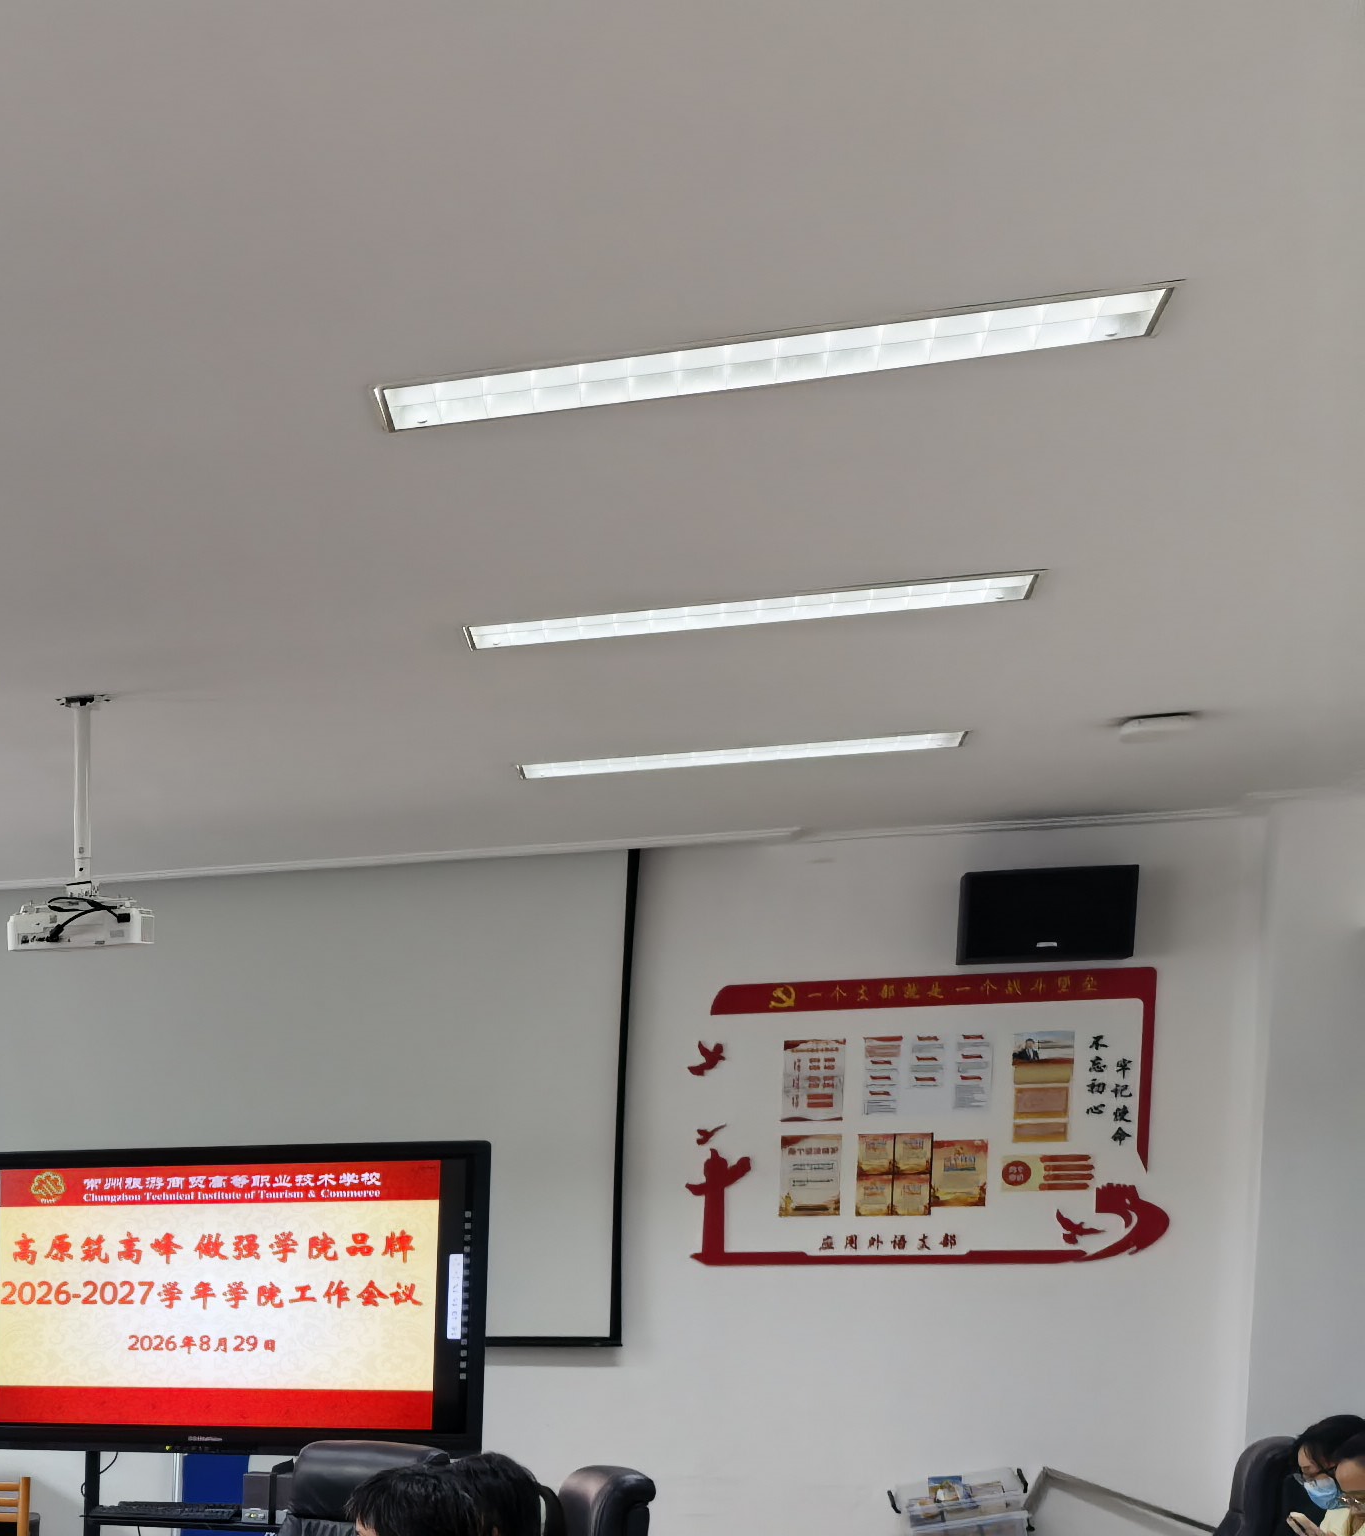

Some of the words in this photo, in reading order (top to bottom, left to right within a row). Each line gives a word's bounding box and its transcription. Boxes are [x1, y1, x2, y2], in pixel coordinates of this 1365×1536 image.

[1085, 1034, 1109, 1115] 不忘初心
[1110, 1057, 1133, 1146] 牢记使命
[82, 1171, 382, 1191] 常州旅游商贸高等职业技术学校
[197, 1190, 242, 1200] Institute
[244, 1190, 256, 1199] of
[257, 1189, 304, 1199] Tourism
[307, 1190, 317, 1198] &
[12, 1231, 184, 1265] 高原筑高峰
[193, 1229, 417, 1264] 做强学院品牌
[818, 1232, 958, 1251] 应用外语支部
[0, 1279, 424, 1310] 2026-2027学年学院工作会议
[127, 1333, 277, 1355] 2026年8月29日
